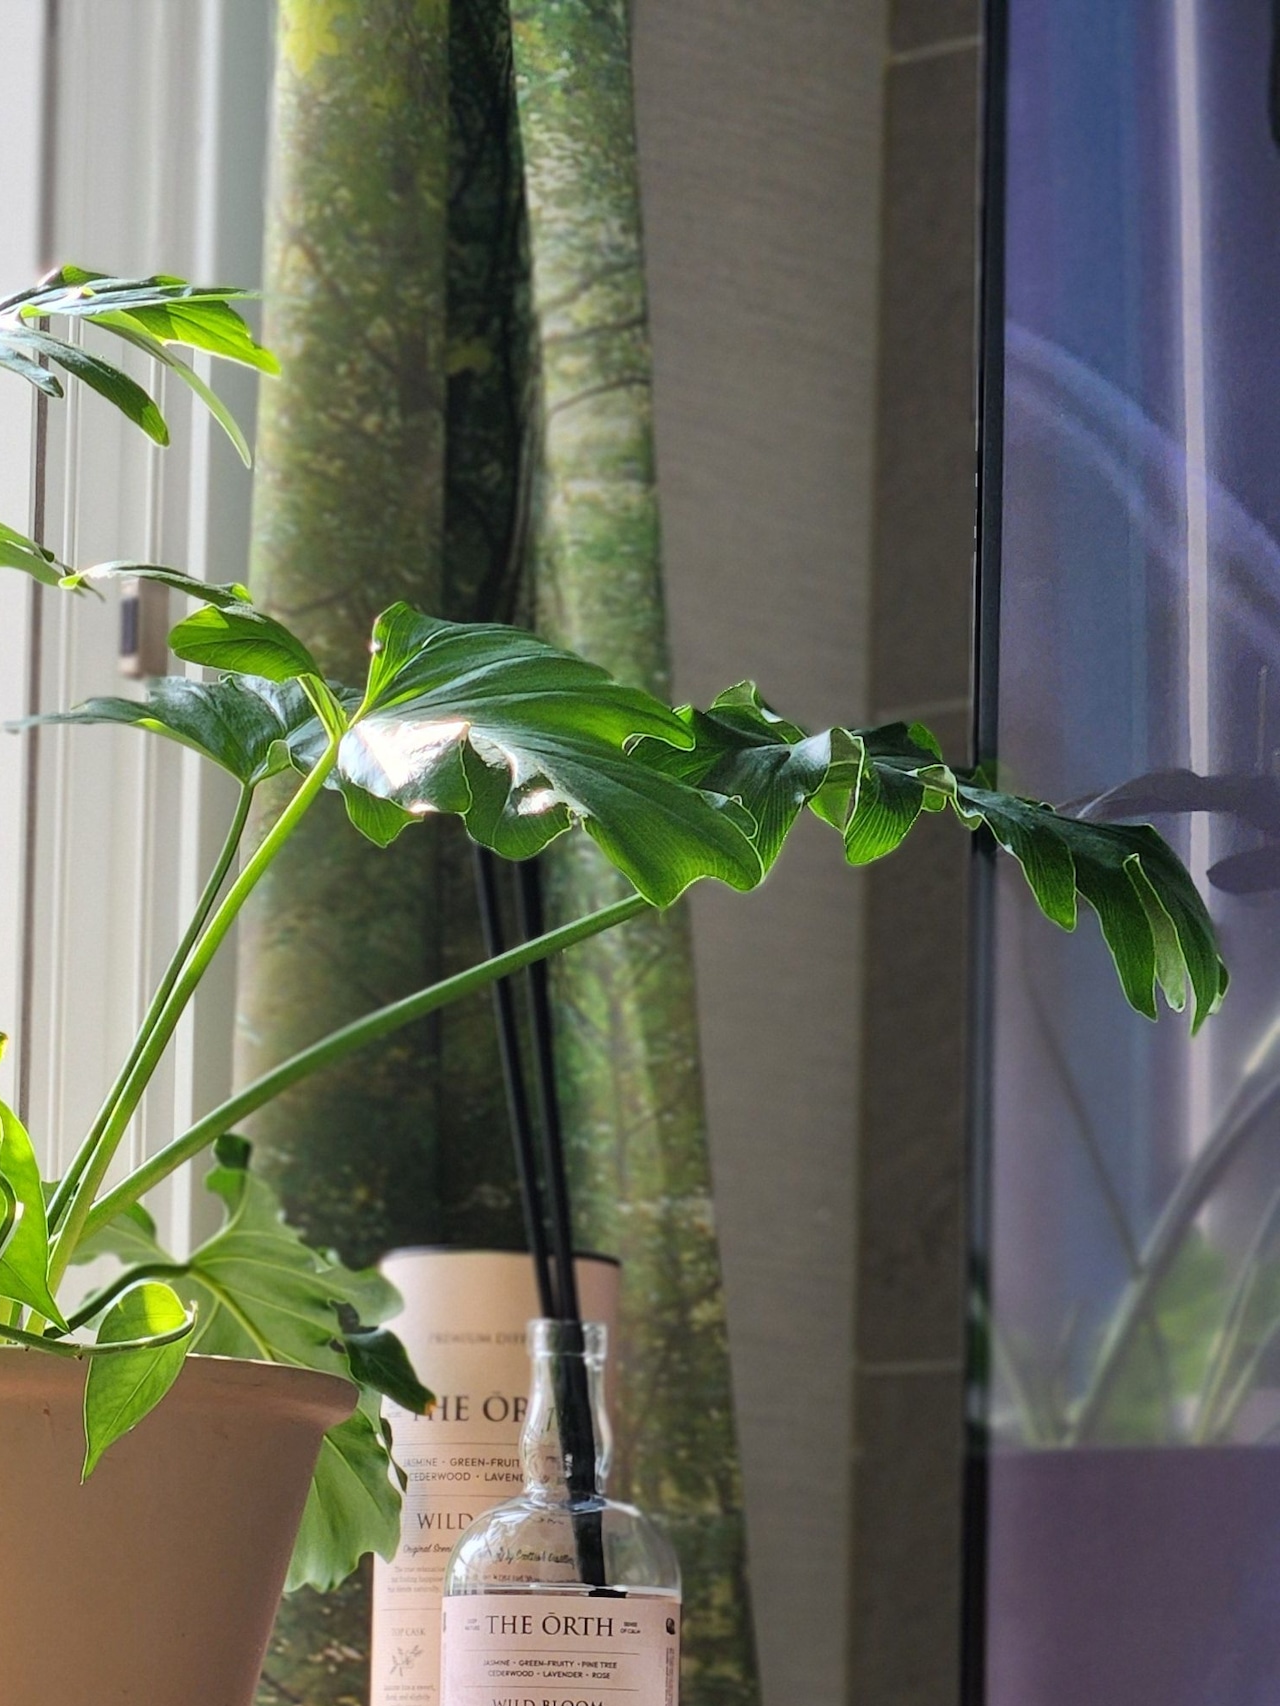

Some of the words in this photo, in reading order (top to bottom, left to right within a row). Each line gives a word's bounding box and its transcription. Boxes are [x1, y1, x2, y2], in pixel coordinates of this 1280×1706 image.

[414, 1395, 470, 1422] HE
[449, 1458, 521, 1468] GREEN-FRUIT
[485, 1614, 533, 1635] THE
[542, 1671, 583, 1679] LAVENDER
[591, 1672, 611, 1680] ROSE
